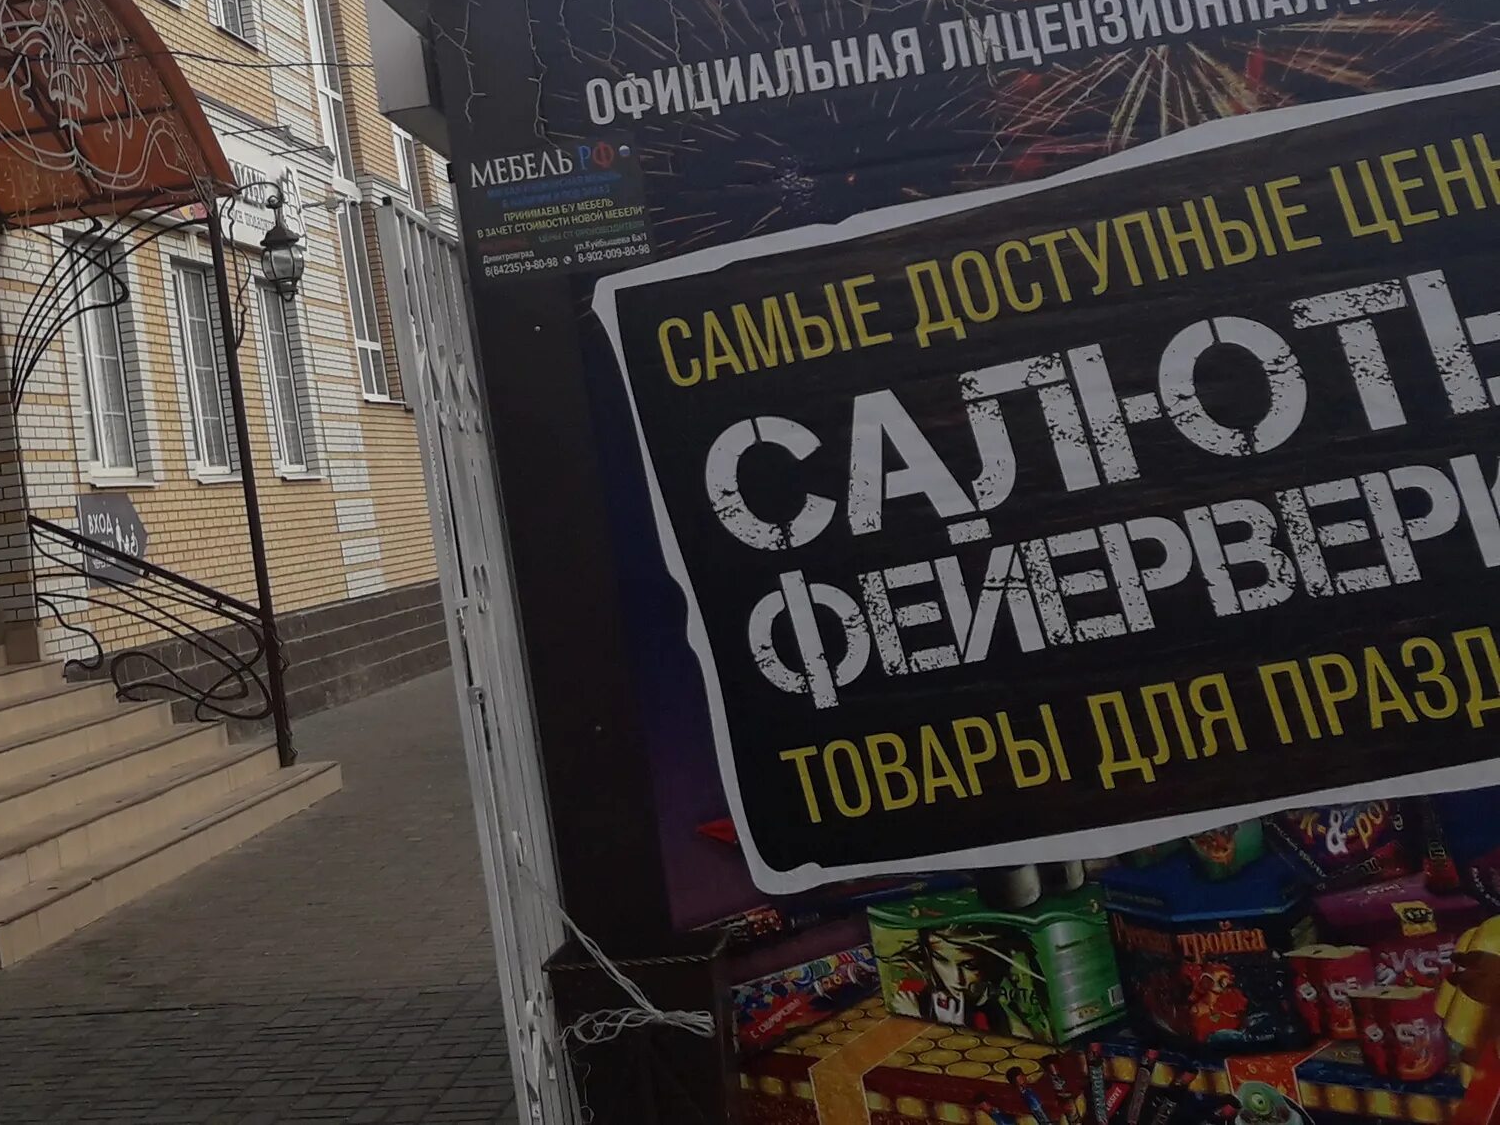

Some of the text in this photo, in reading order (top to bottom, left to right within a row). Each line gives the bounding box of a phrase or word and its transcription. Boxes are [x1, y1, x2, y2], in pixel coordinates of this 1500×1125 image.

[586, 27, 925, 125] ОФИЦИАЛЬНАЯ
[471, 149, 573, 188] МЕБЕЛЬ
[578, 141, 615, 171] РФ
[485, 222, 513, 237] ЗАЧЕТ
[515, 216, 571, 233] СТОИМОСТИ
[571, 209, 603, 225] НОВОЙ
[503, 205, 560, 222] ПРИНИМАЕМ
[577, 198, 614, 212] МЕБЕЛЬ
[577, 243, 651, 264] 8-902-009-80-98
[657, 273, 893, 387] САМЫЕ
[906, 176, 1322, 349] ДОСТУПНЫЕ
[87, 512, 114, 535] ВХОД
[779, 703, 1072, 824] ТОВАРЫ
[1086, 672, 1248, 790] ДЛЯ
